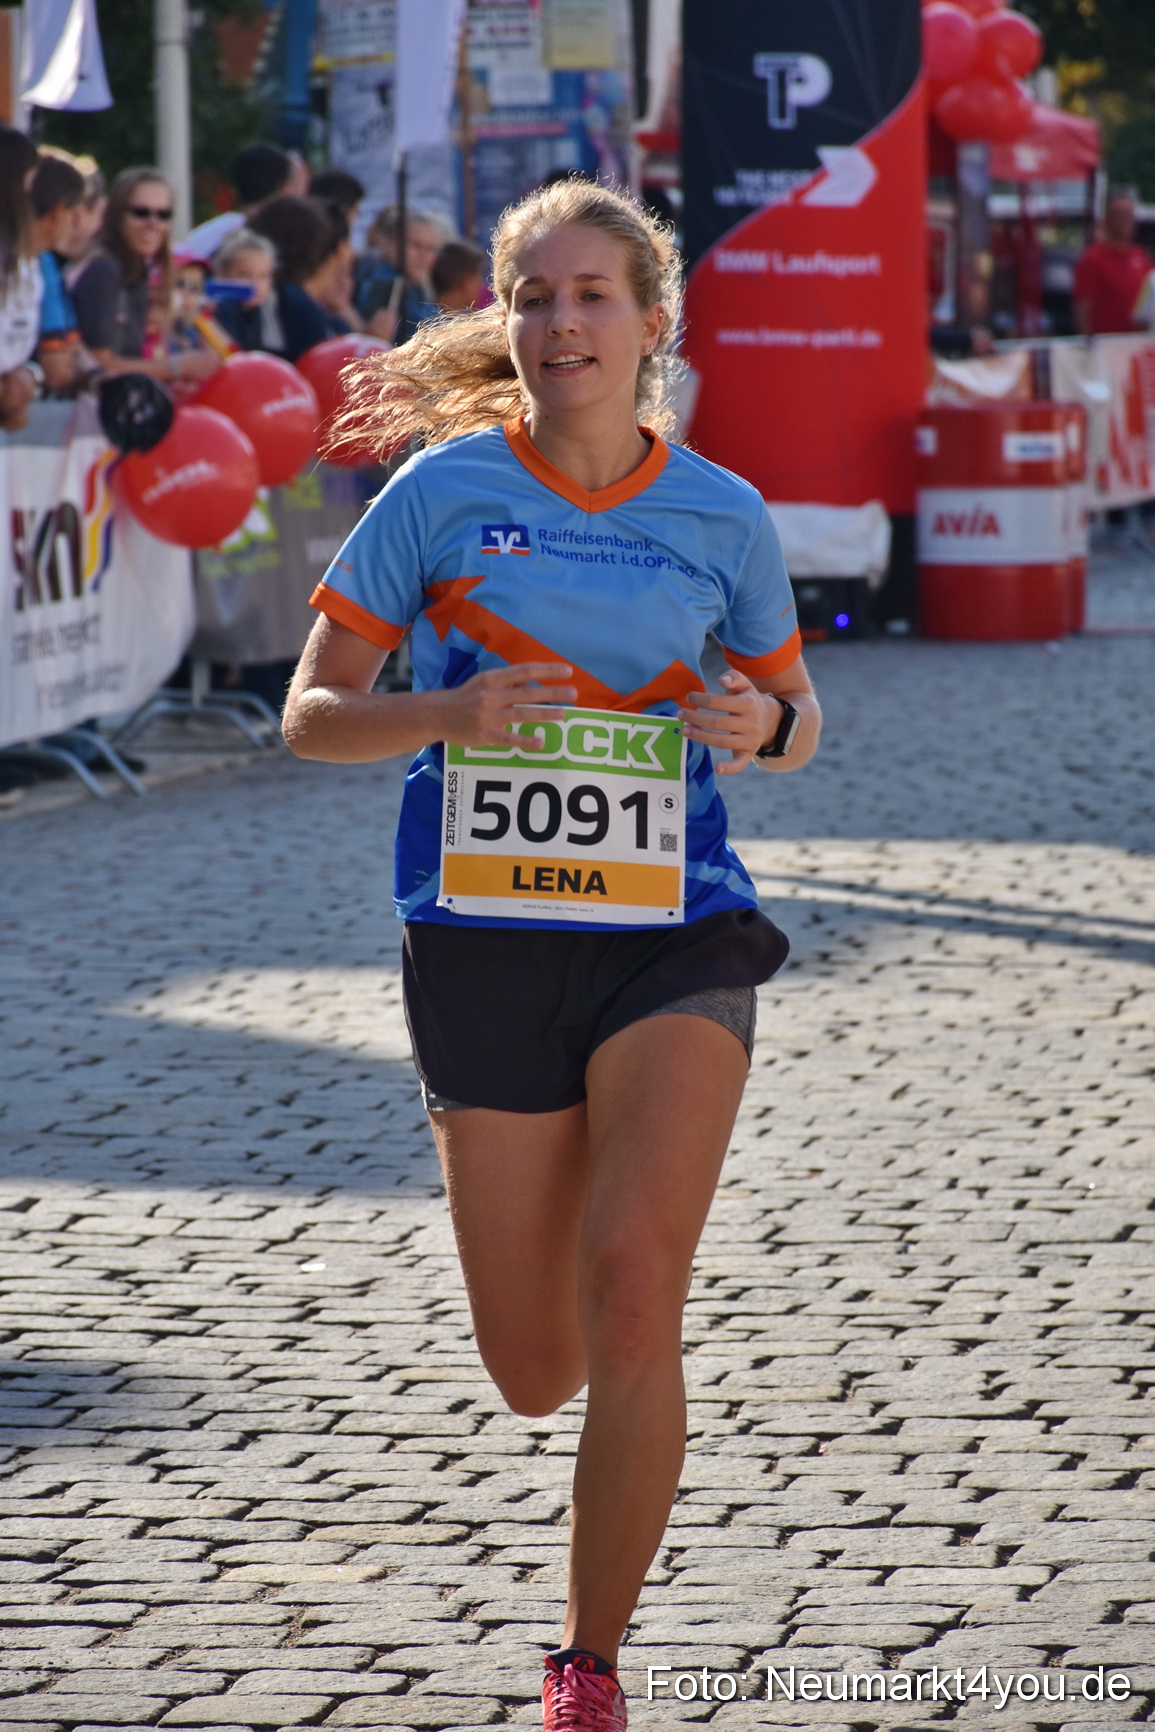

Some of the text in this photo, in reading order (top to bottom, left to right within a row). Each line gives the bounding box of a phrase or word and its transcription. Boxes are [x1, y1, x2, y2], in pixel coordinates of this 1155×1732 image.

[773, 251, 881, 278] Laufsport
[537, 528, 653, 552] Raiffeisenbank
[541, 544, 616, 565] Neumarkt
[470, 780, 649, 850] 5091
[664, 797, 674, 809] S
[512, 865, 608, 895] LENA
